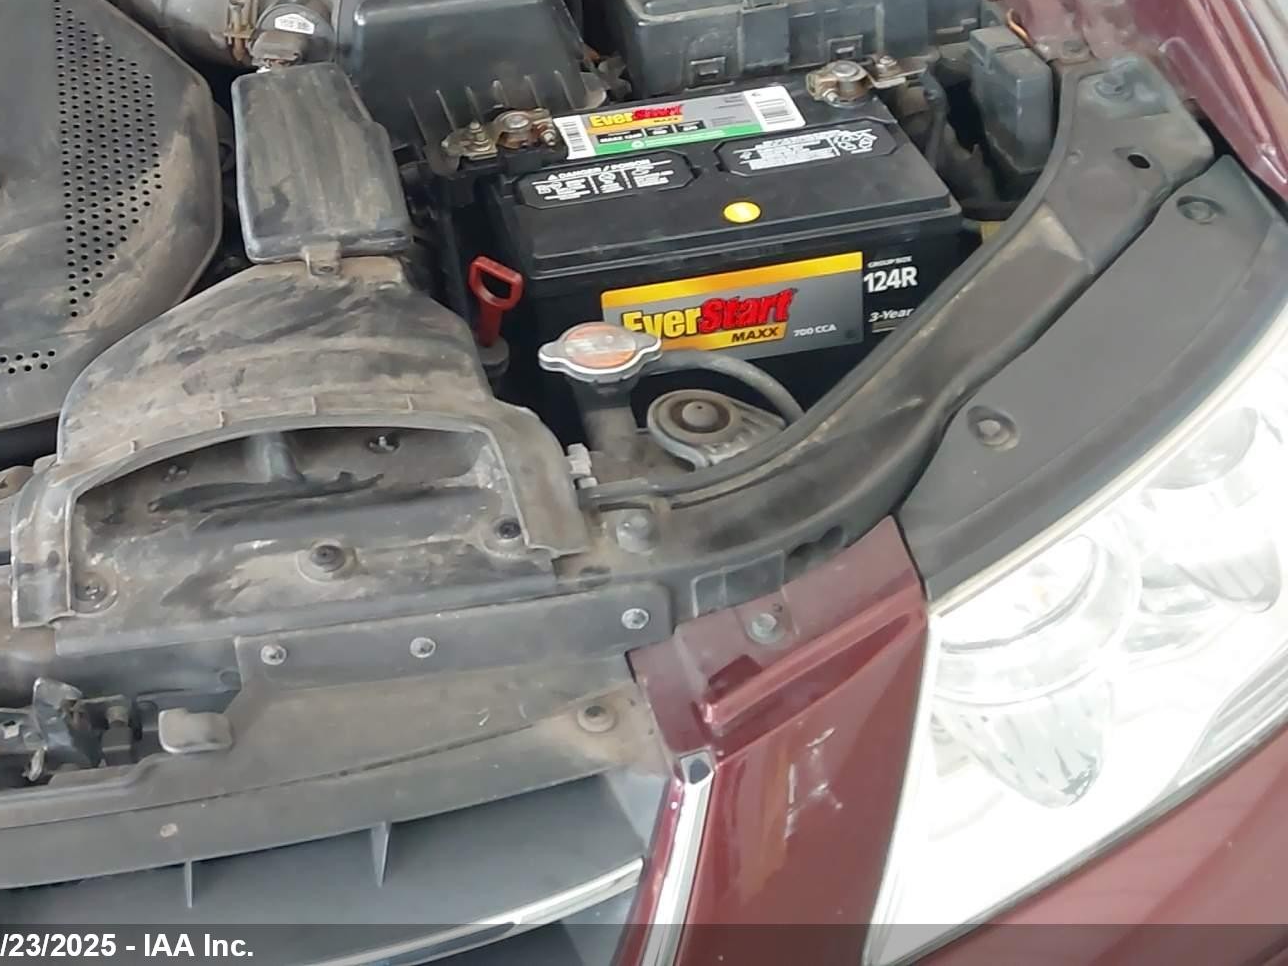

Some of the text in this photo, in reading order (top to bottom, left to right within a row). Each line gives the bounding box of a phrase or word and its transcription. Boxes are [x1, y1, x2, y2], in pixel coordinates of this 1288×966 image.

[863, 265, 918, 293] 124R
[621, 287, 796, 339] EverStart
[867, 307, 915, 323] 3-Year
[730, 325, 781, 344] MAXX
[792, 323, 837, 337] 700 CCA
